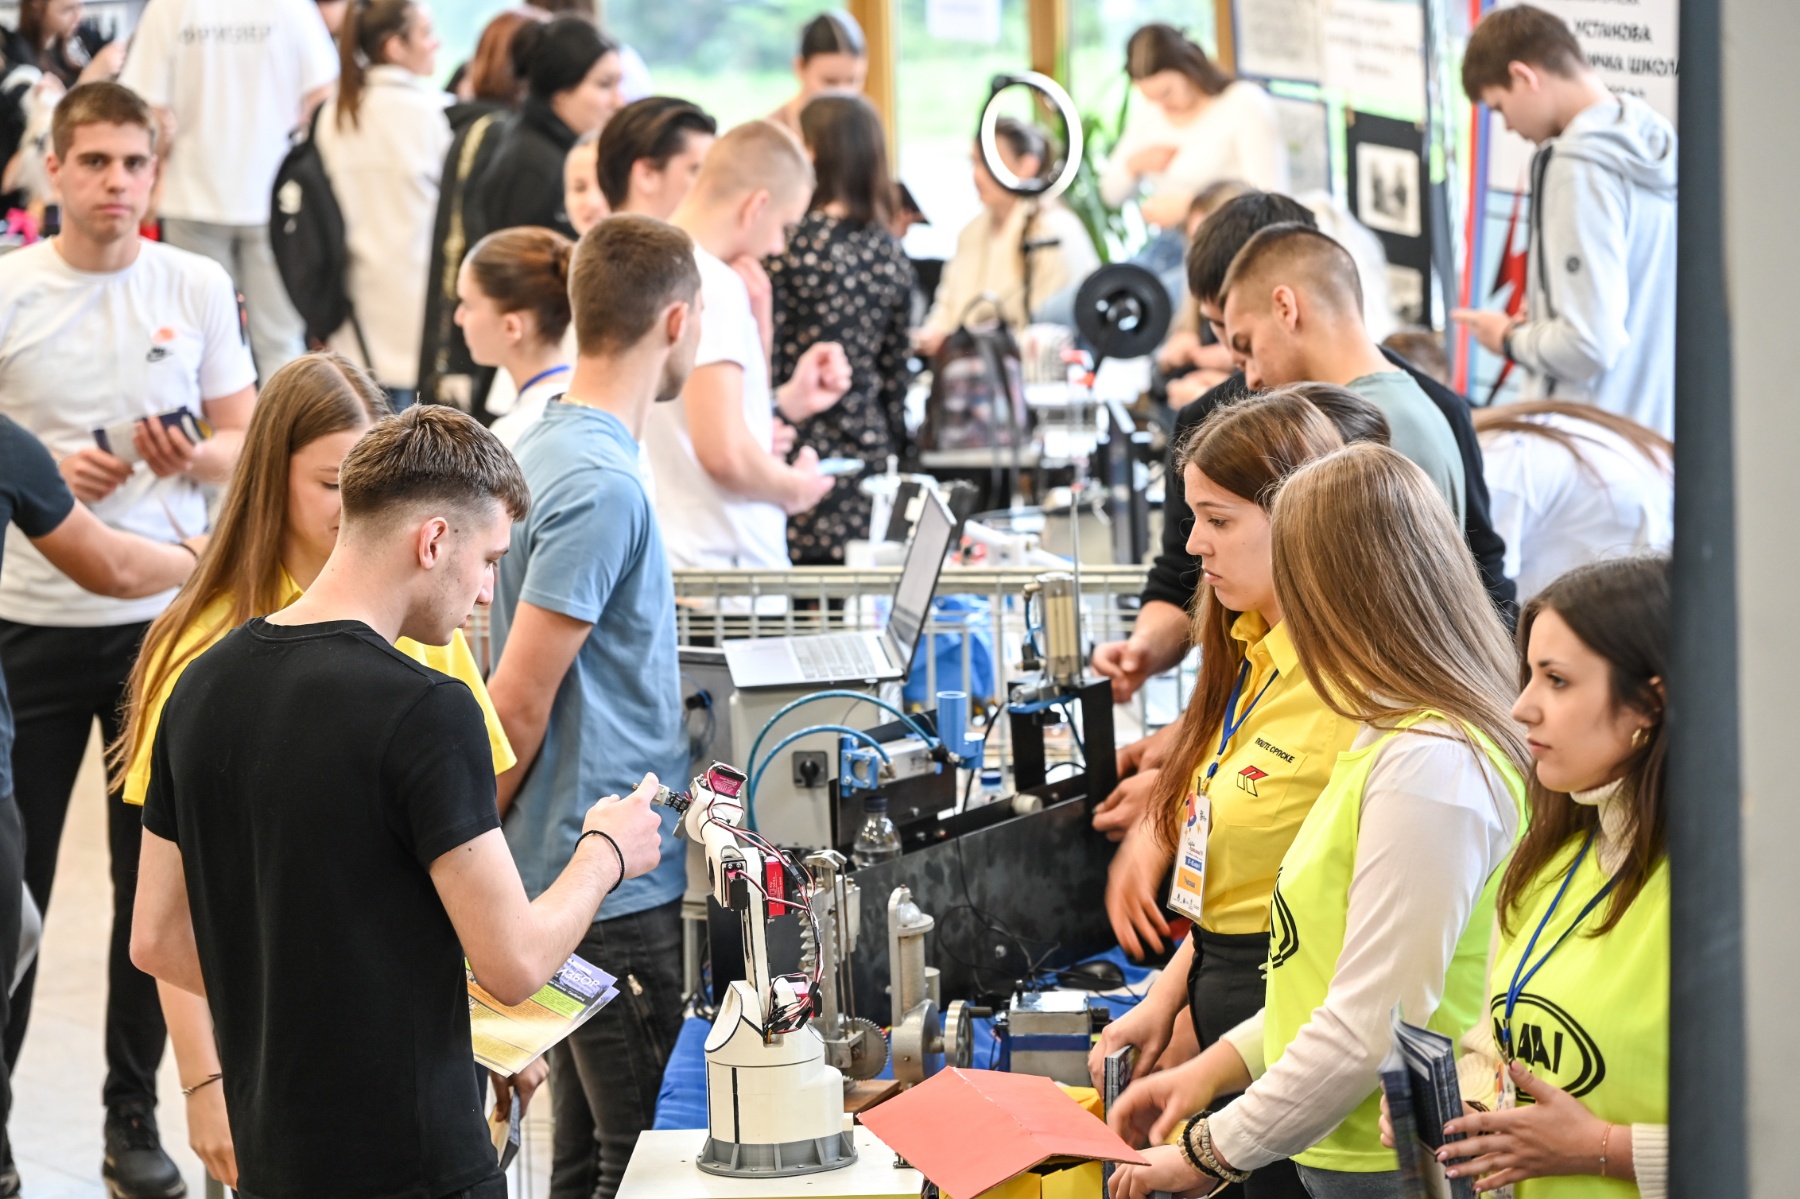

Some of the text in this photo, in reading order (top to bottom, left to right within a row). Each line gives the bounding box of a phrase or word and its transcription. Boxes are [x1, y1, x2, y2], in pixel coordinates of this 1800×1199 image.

[1574, 21, 1650, 41] УСТАНОВА
[1586, 53, 1623, 71] ИЧКА
[1270, 746, 1295, 763] СРПСКЕ
